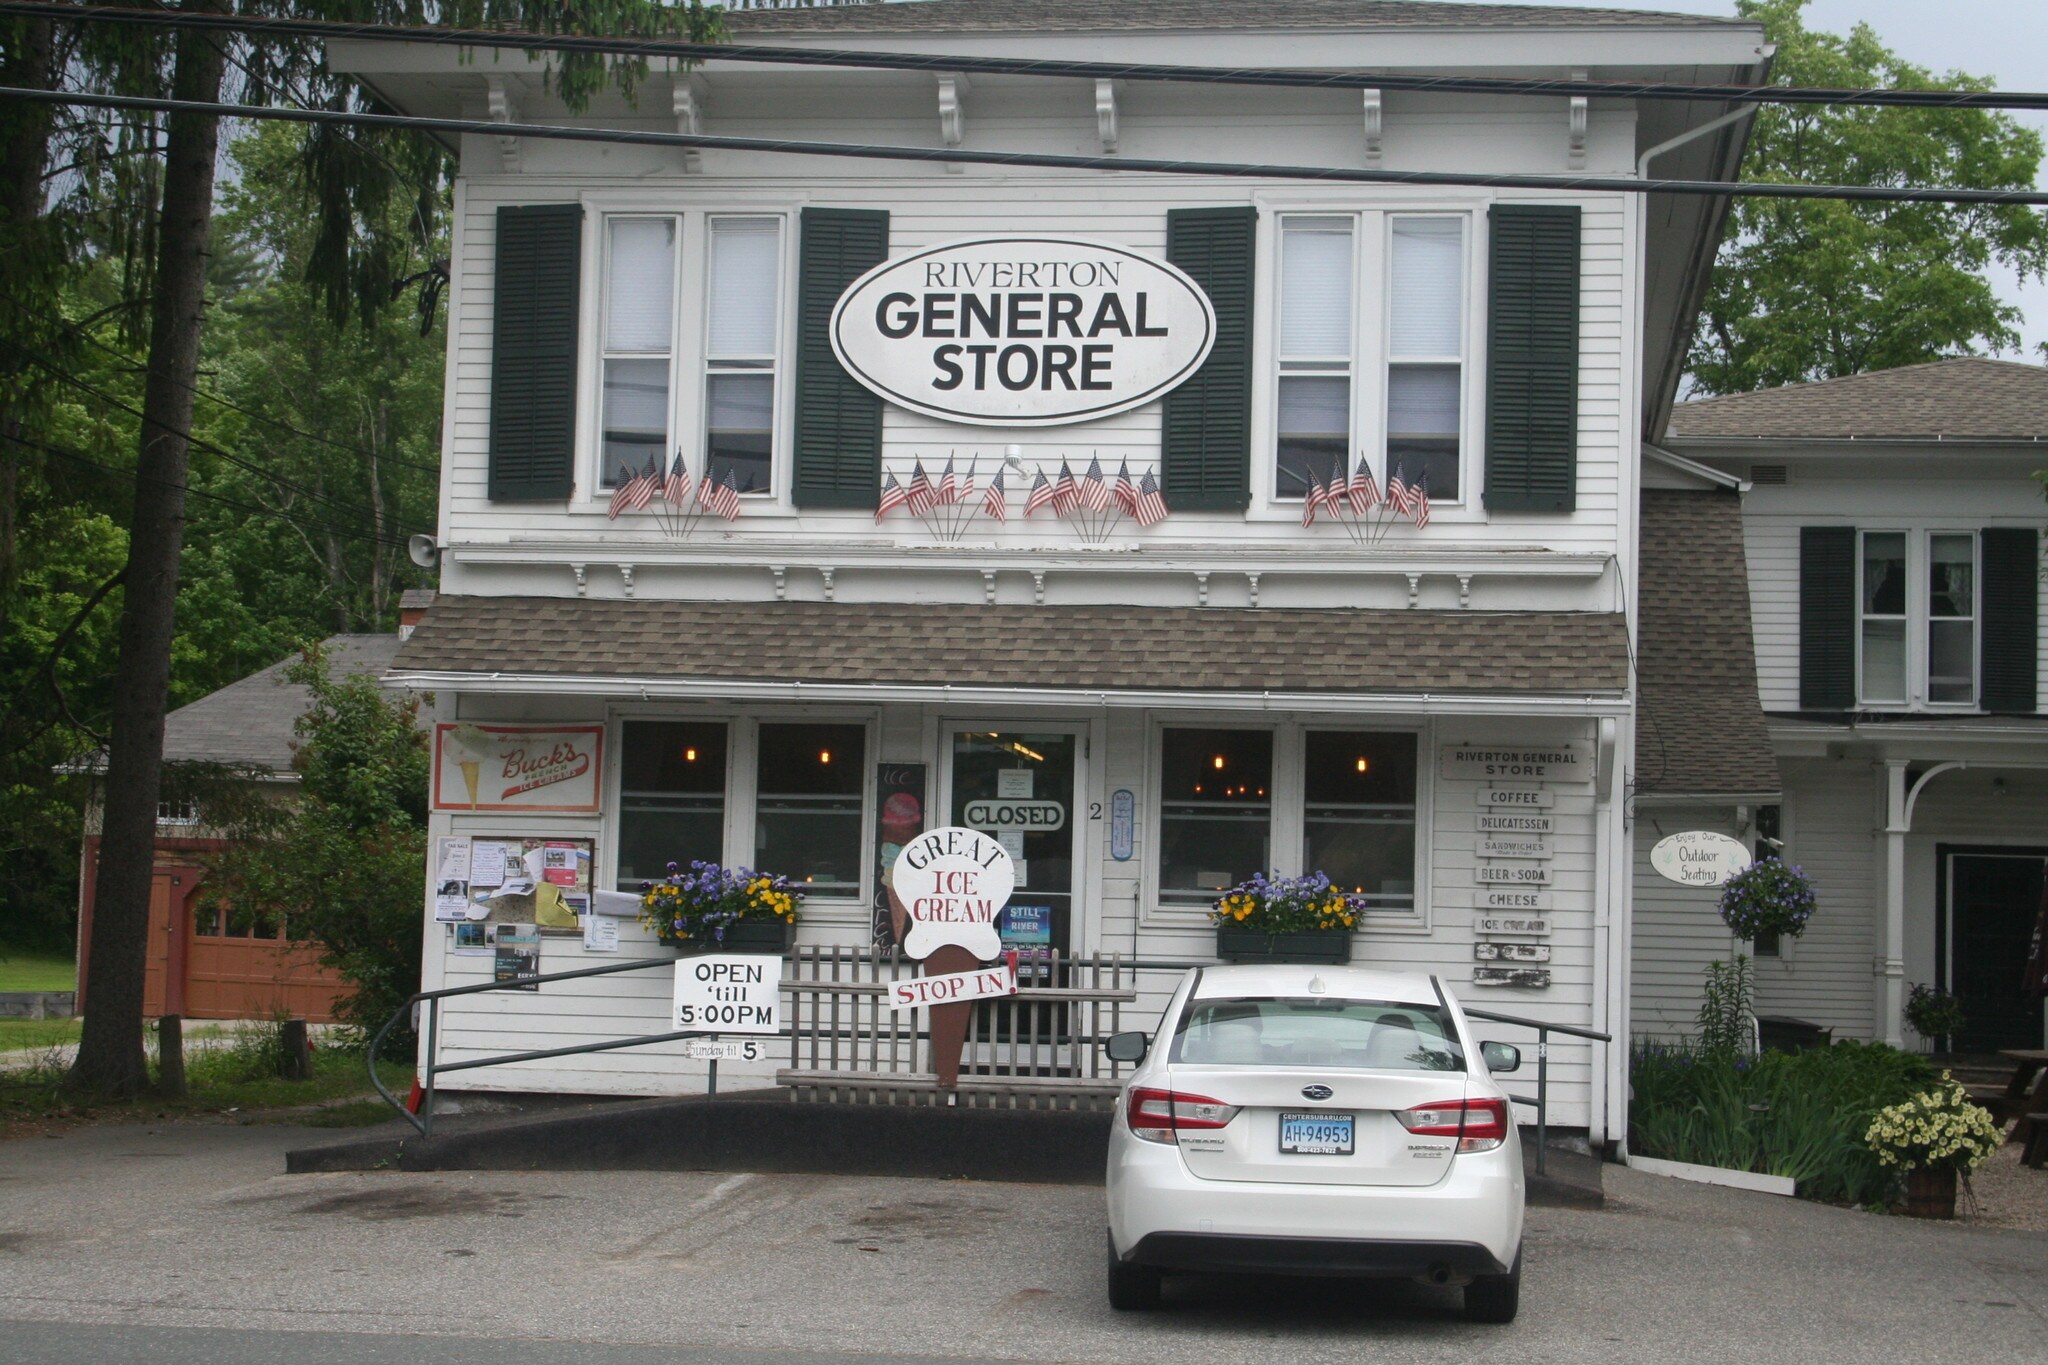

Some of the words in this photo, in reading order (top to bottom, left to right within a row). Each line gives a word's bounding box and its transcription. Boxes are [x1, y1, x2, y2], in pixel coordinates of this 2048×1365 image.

[922, 260, 1123, 288] RIVERTON
[875, 291, 1169, 340] GENERAL
[931, 343, 1114, 392] STORE
[500, 742, 578, 778] Buck's
[1456, 751, 1519, 762] RIVERTON
[1523, 753, 1577, 764] GENERAL
[524, 764, 568, 781] FRENCH
[1485, 765, 1546, 776] STORE
[519, 782, 536, 792] ICE
[1490, 792, 1539, 804] COFFEE
[967, 805, 1063, 826] CLOSED
[1089, 802, 1103, 820] 2
[1481, 816, 1549, 830] DELICATESSEN
[1484, 841, 1545, 851] SANDWICHES
[1675, 833, 1697, 844] Enjoy
[1702, 832, 1717, 842] Our
[905, 831, 1005, 870] GREAT
[1678, 846, 1720, 862] Outdoor
[932, 870, 979, 896] ICE
[1481, 868, 1510, 880] BEER
[1517, 869, 1546, 881] SODA
[1680, 865, 1718, 885] Seating
[1488, 894, 1539, 906] CHEESE
[913, 898, 993, 923] CREAM
[1010, 907, 1041, 918] STILL
[1011, 921, 1039, 931] RIVER
[1481, 919, 1499, 930] ICE
[1502, 920, 1545, 931] CREAM
[695, 963, 762, 984] OPEN
[896, 976, 965, 1005] STOP
[680, 1004, 772, 1025] 5:00PM
[689, 1043, 724, 1058] Sunday
[742, 1041, 757, 1060] 5
[1282, 1113, 1353, 1121] CENTERSUBARU.COM
